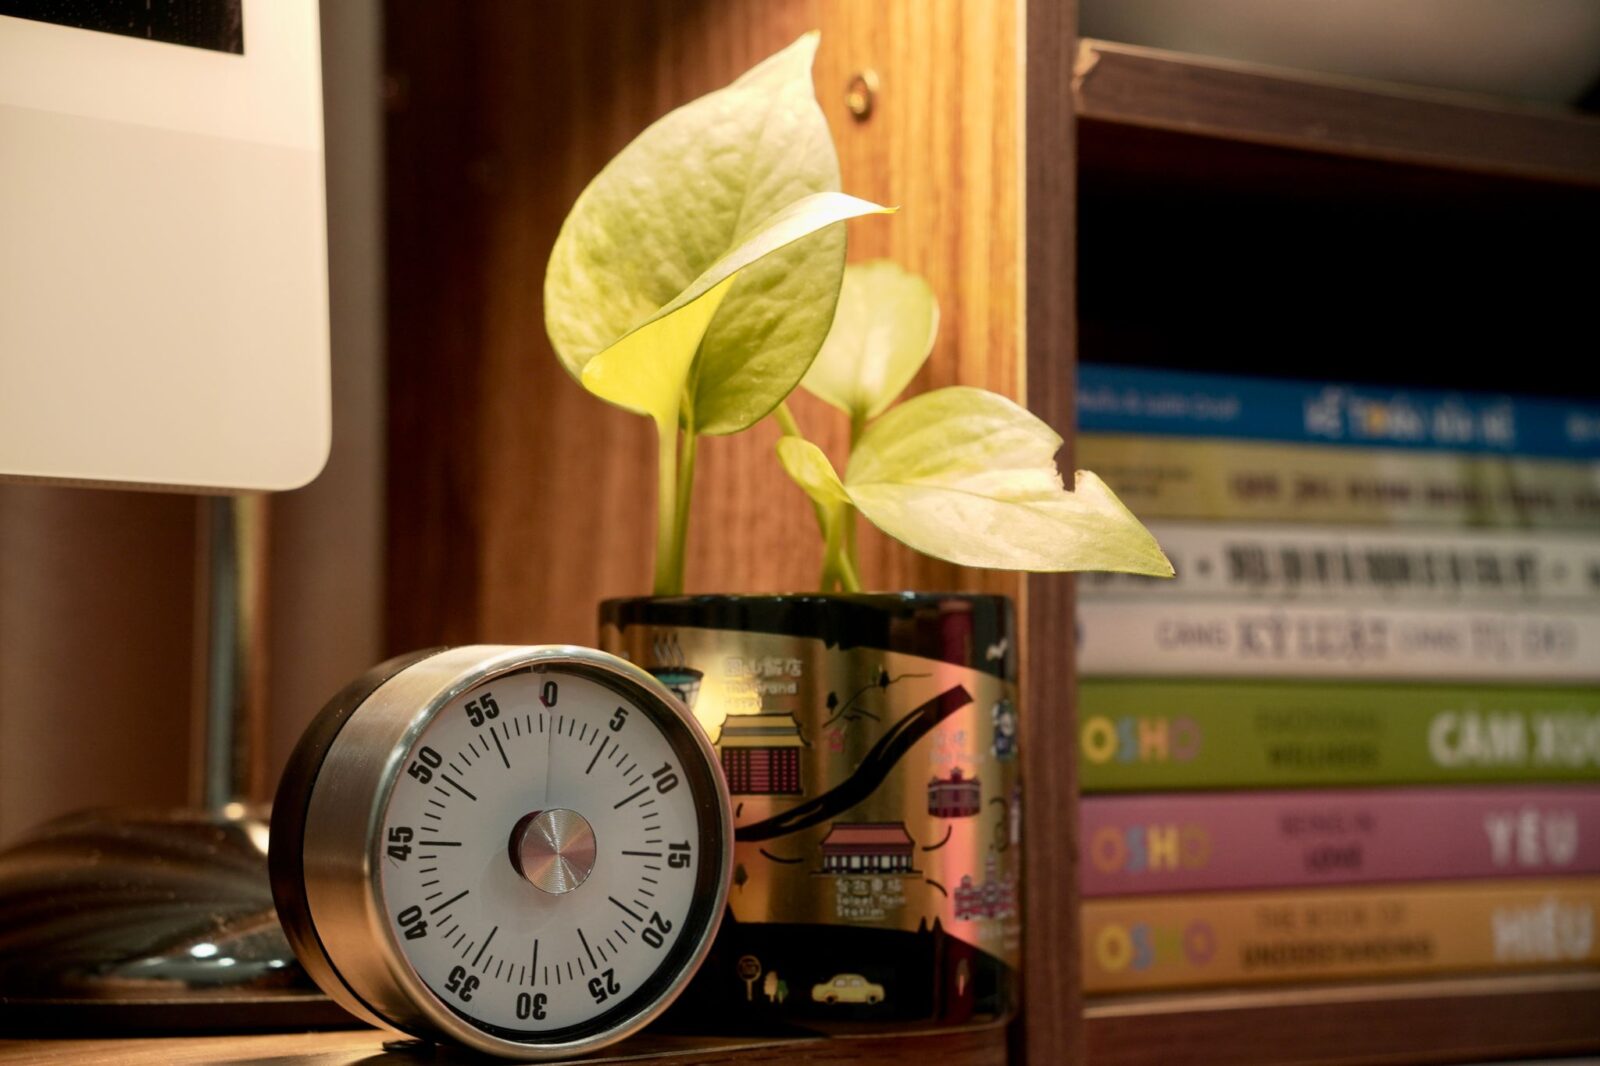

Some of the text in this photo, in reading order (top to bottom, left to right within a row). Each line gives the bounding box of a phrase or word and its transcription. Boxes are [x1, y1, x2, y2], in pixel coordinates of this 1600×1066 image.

[464, 692, 500, 728] 55
[543, 681, 558, 708] 0
[609, 706, 628, 732] 5
[1081, 716, 1204, 763] OSHO
[407, 746, 443, 784] 50
[651, 761, 680, 795] 10
[387, 826, 414, 861] 45
[667, 839, 691, 869] 15
[1092, 825, 1208, 874] OSHO
[397, 905, 428, 941] 40
[641, 911, 673, 949] 20
[1096, 920, 1216, 971] OSHO
[444, 965, 481, 1002] 35
[587, 968, 621, 1004] 25
[516, 992, 547, 1020] 30
